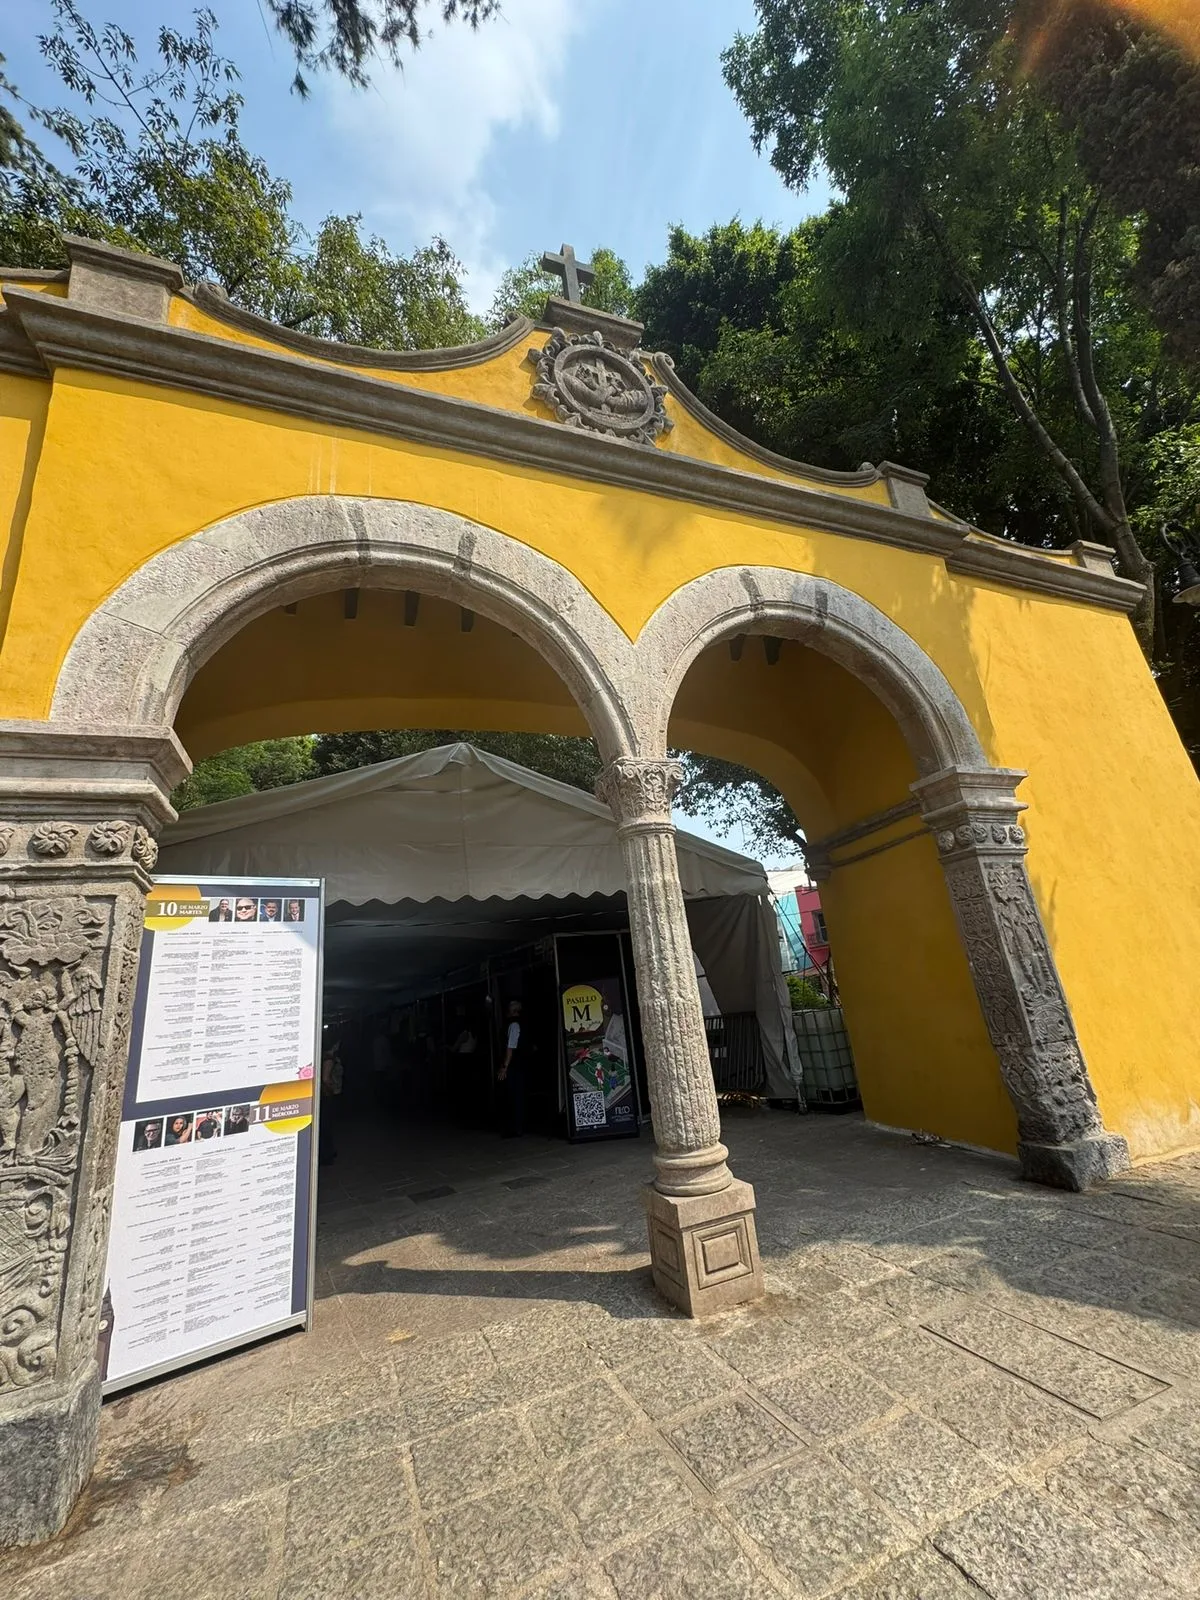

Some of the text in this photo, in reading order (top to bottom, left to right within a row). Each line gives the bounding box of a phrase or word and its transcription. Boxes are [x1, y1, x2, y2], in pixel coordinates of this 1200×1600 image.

[157, 902, 178, 916] 10
[566, 995, 597, 1005] PASILLO
[572, 1004, 592, 1022] M
[253, 1105, 272, 1123] 11
